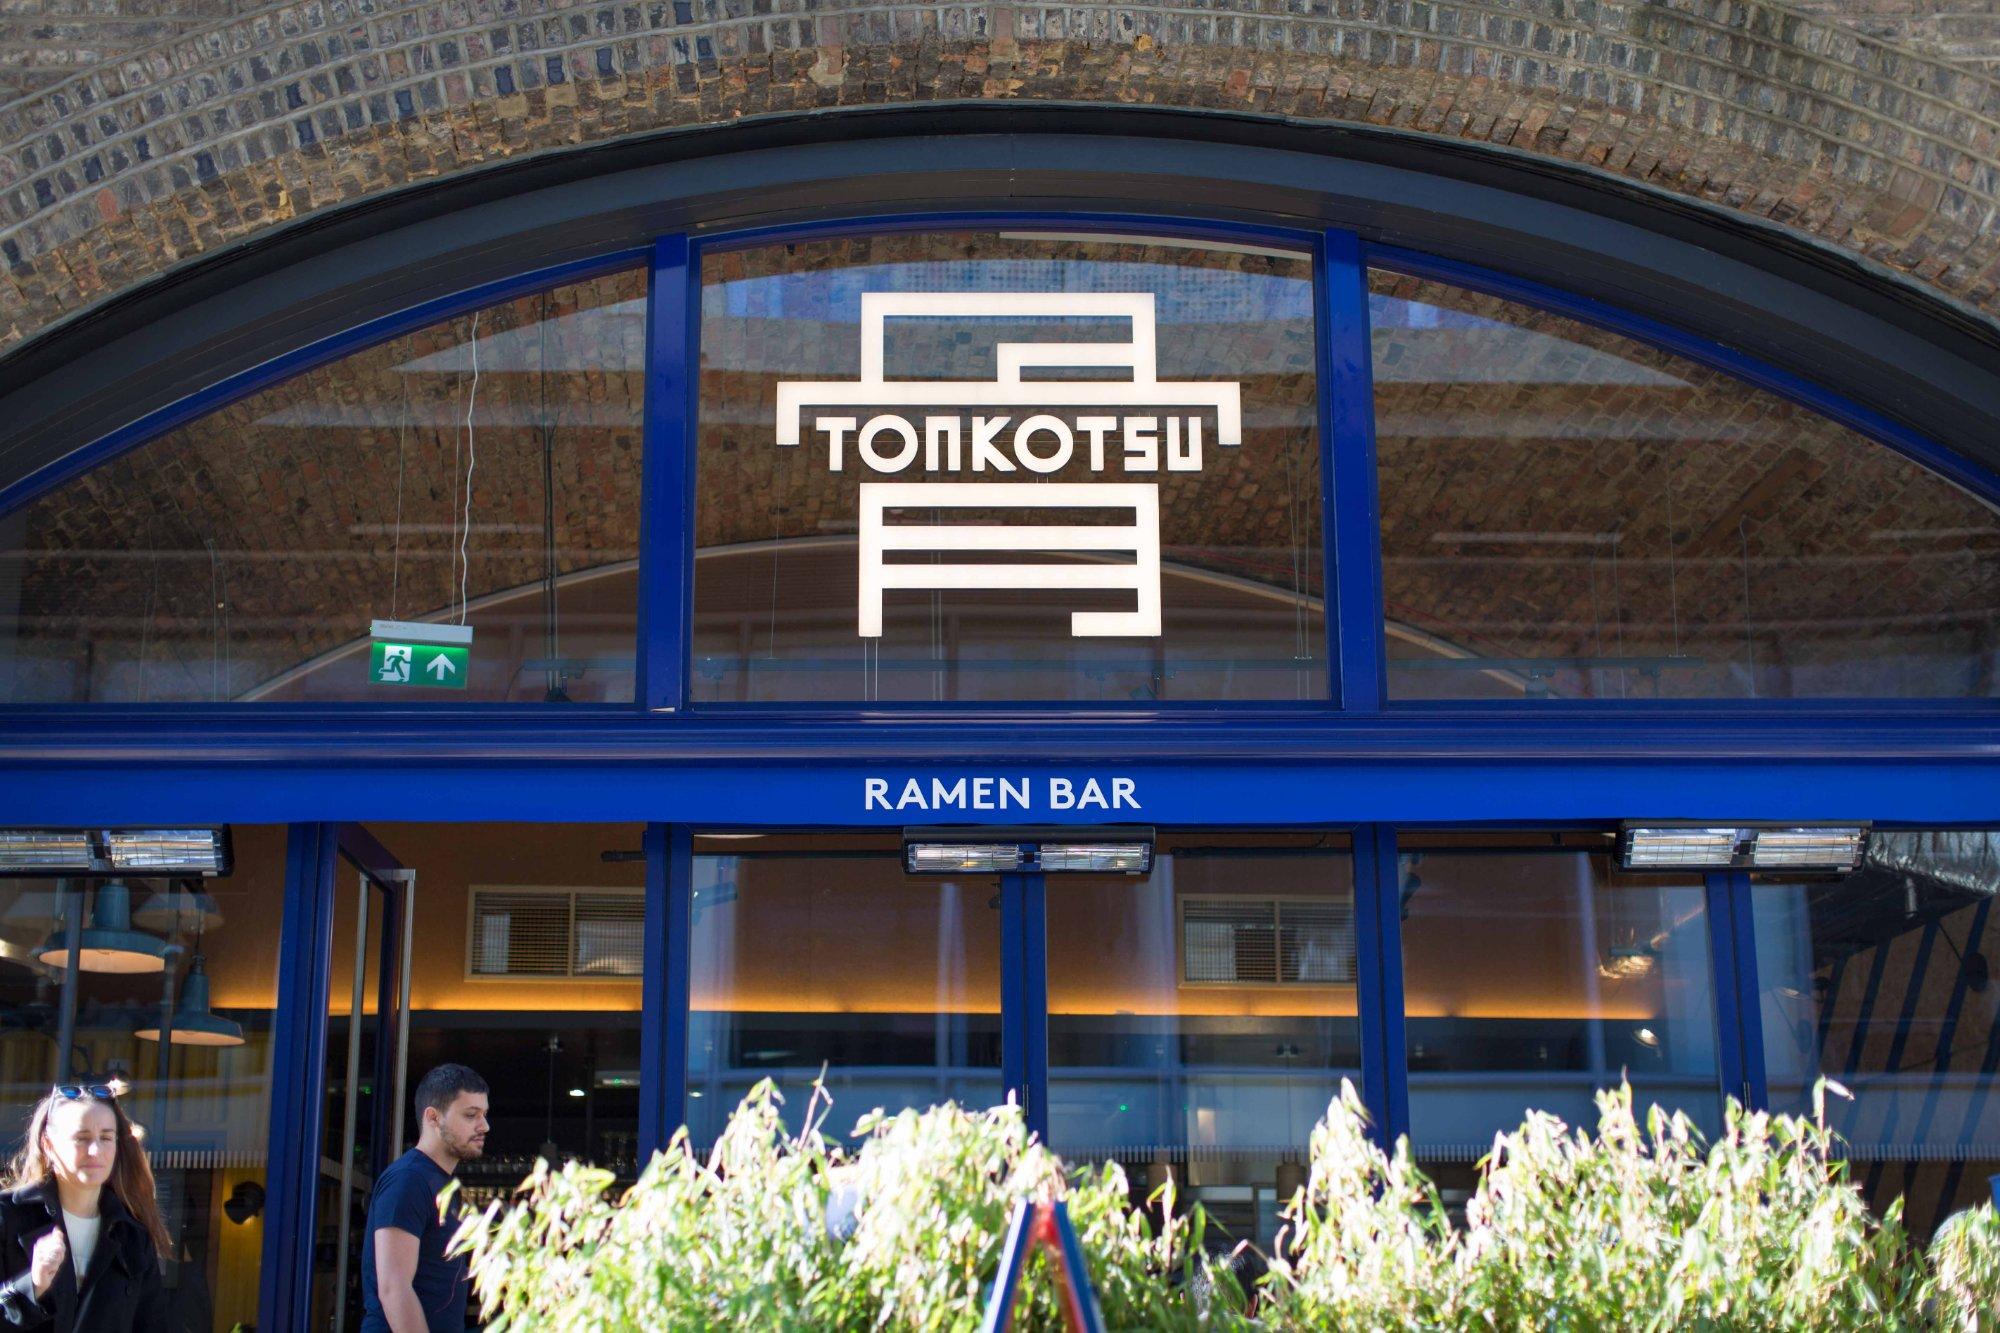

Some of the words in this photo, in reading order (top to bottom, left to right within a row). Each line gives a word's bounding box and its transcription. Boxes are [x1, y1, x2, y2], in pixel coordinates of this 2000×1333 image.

[815, 414, 1203, 473] TONKOTSU
[865, 777, 1030, 810] RAMEN
[1050, 777, 1142, 810] BAR
